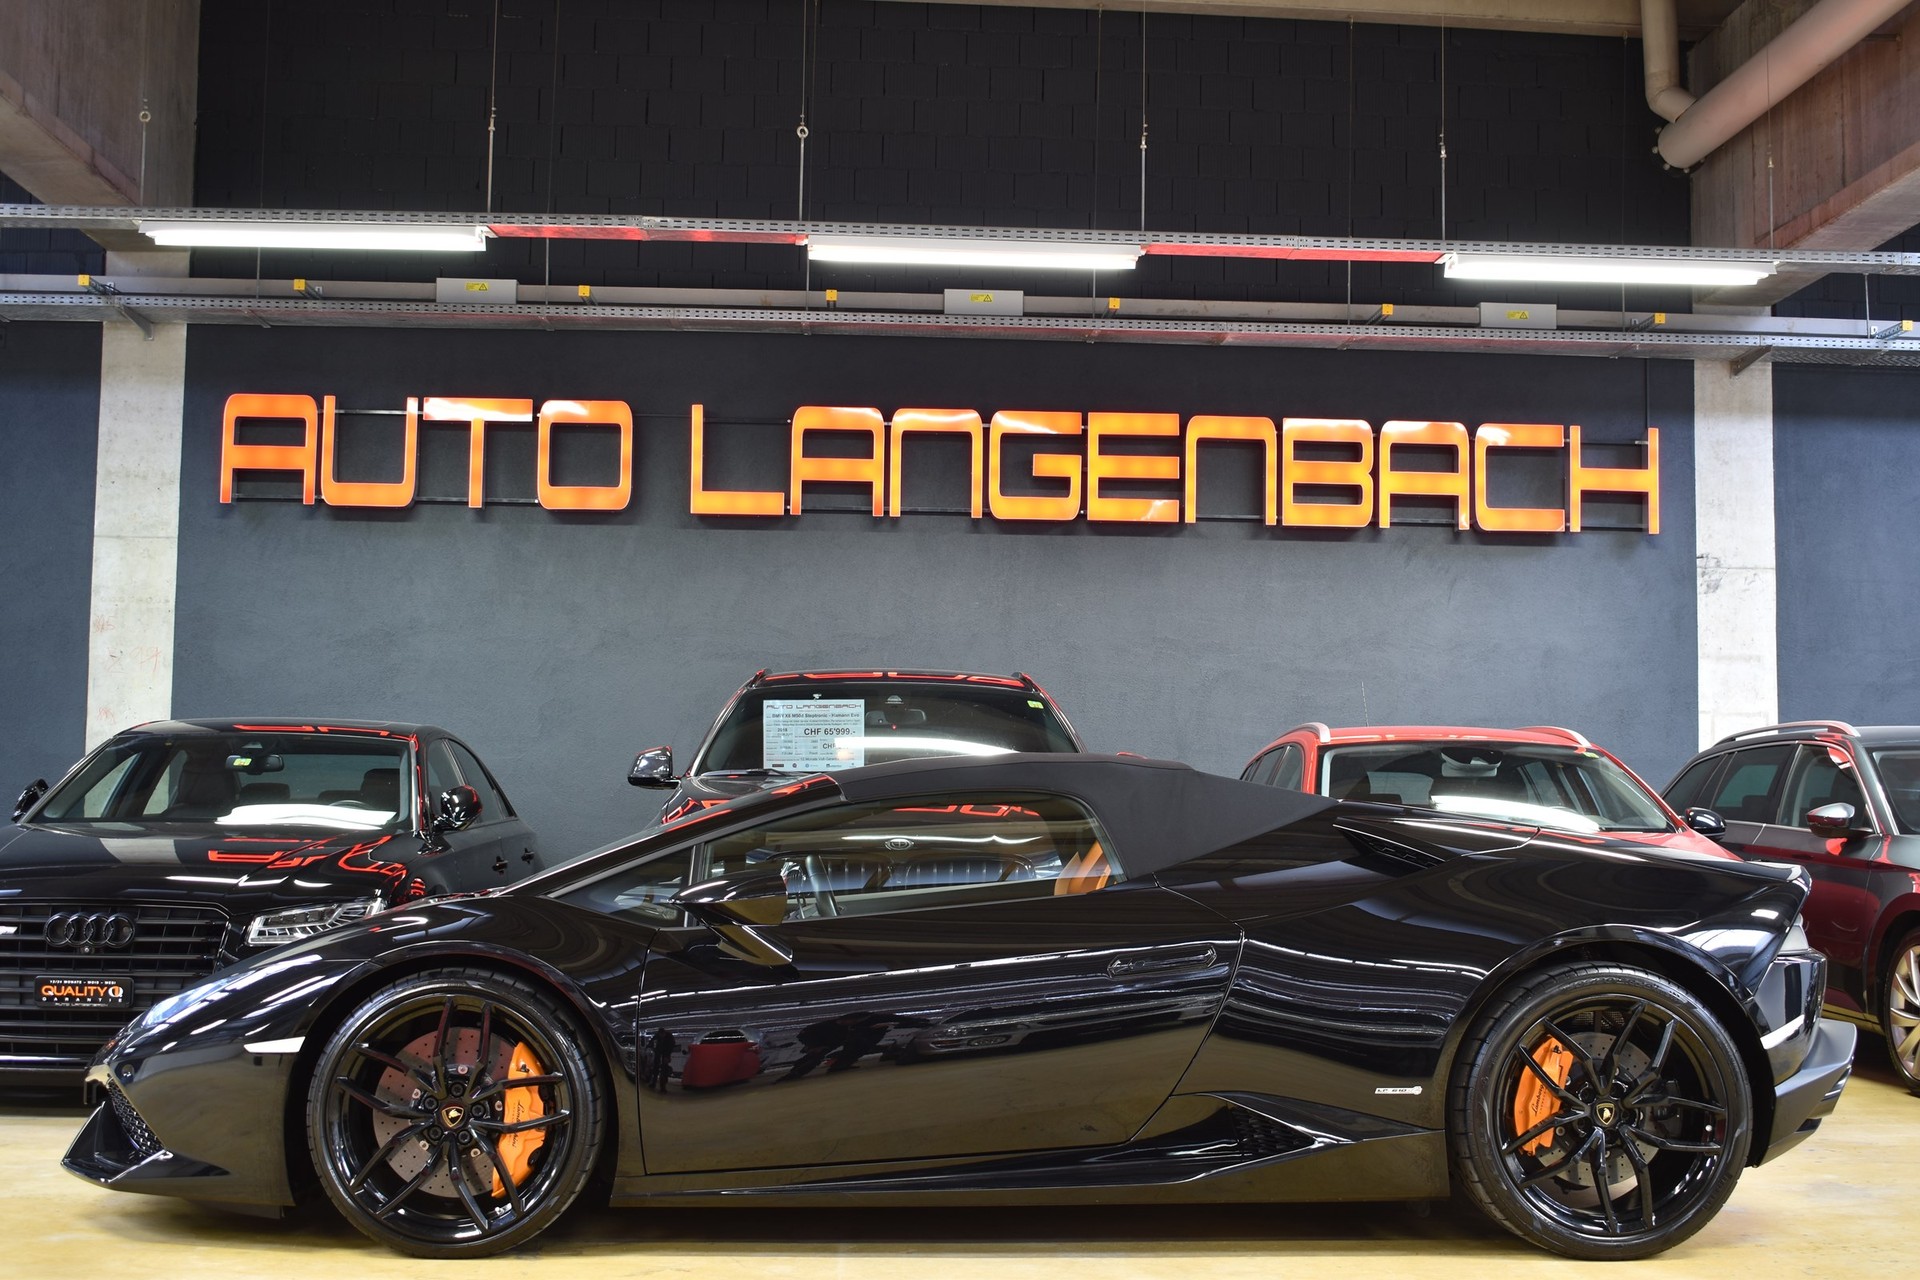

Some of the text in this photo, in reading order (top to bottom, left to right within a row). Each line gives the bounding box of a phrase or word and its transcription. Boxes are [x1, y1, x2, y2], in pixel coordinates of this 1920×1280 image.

[219, 392, 1661, 535] AUTO LANGENBACH
[803, 728, 822, 736] CHF
[824, 727, 856, 736] 65'999.-
[41, 985, 108, 997] QUALITY
